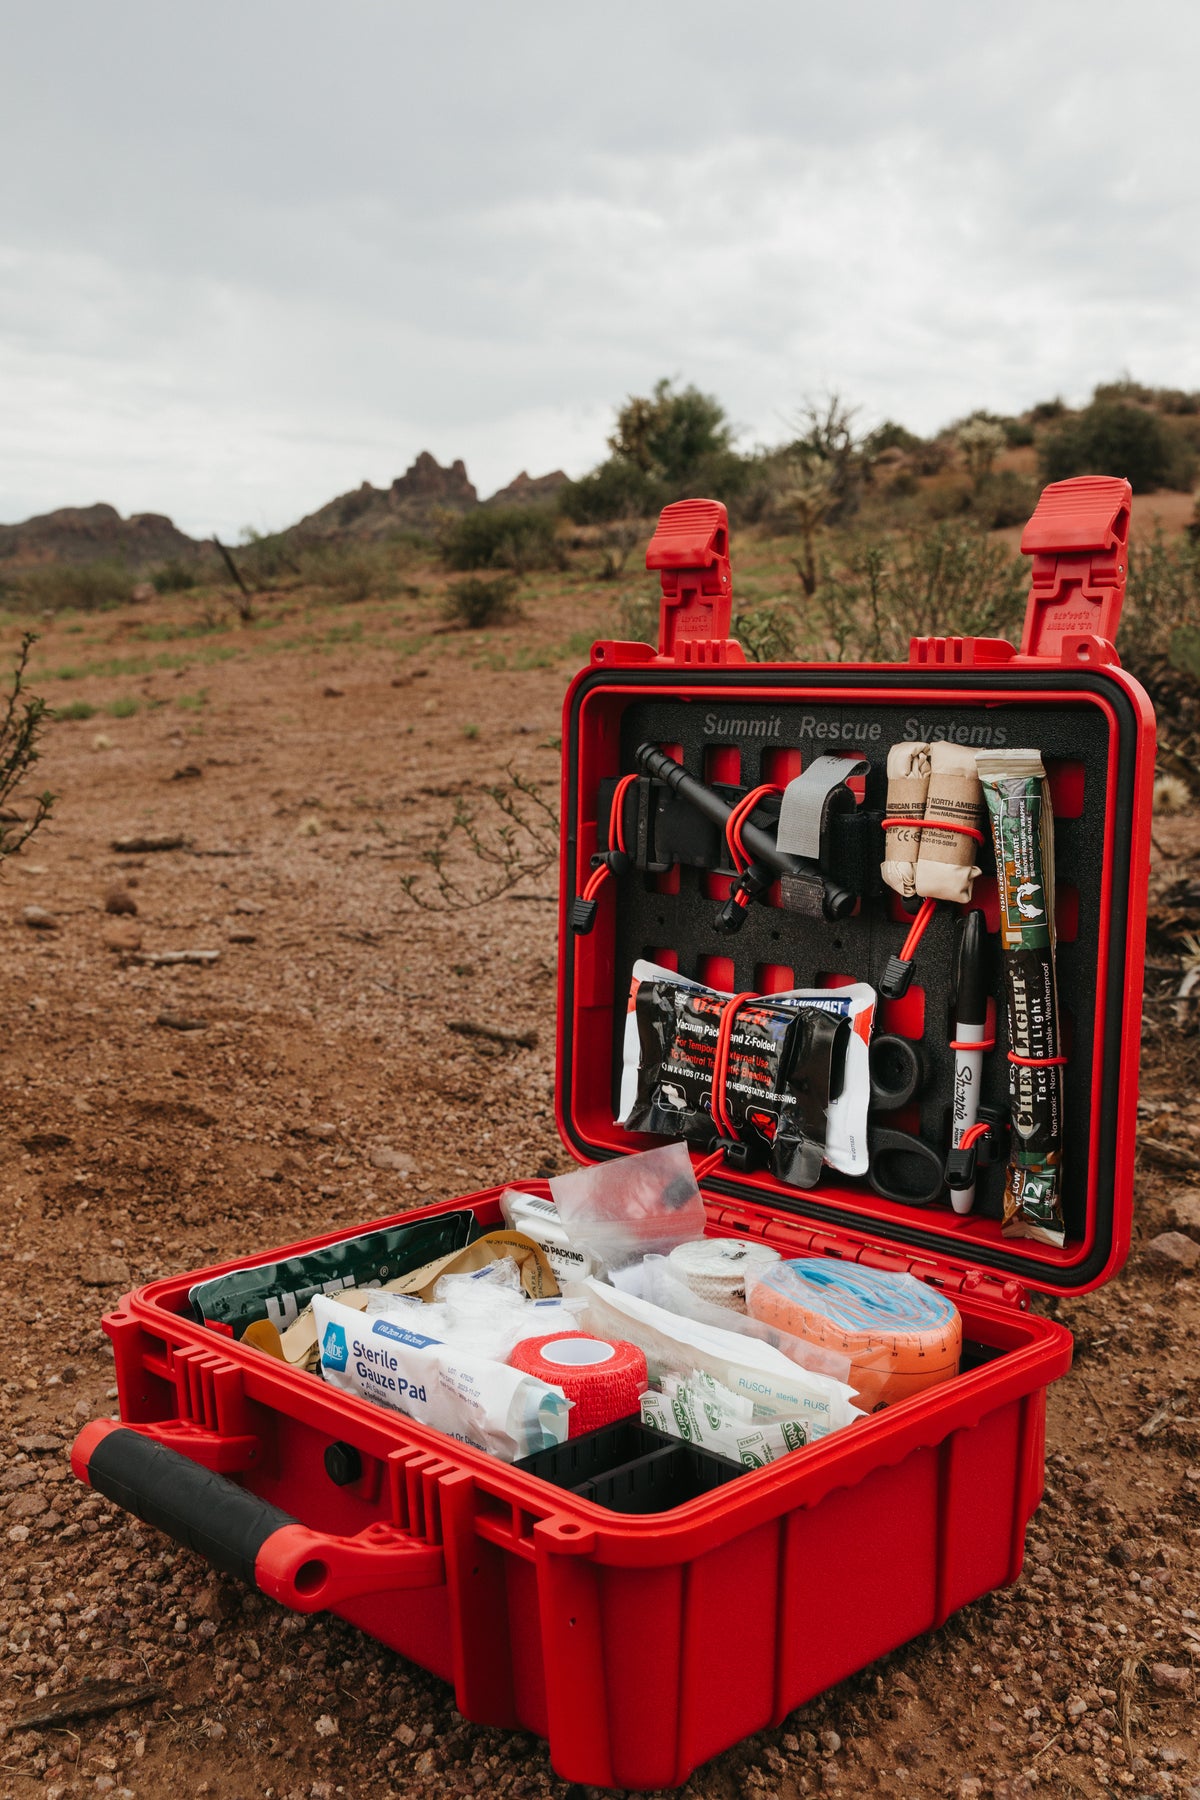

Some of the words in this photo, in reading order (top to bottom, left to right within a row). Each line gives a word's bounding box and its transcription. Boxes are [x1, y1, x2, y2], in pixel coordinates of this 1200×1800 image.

[703, 713, 782, 736] Summit
[800, 716, 882, 740] Rescue
[903, 718, 1008, 745] Systems
[930, 798, 954, 806] NORTH
[1042, 962, 1052, 1021] Weatherproof
[1031, 998, 1044, 1038] Light
[676, 1018, 704, 1034] Vacuum
[730, 1033, 744, 1044] and
[744, 1036, 776, 1052] Z-Folded
[675, 1036, 687, 1047] For
[730, 1051, 755, 1065] xternal
[756, 1057, 769, 1068] Use
[680, 1052, 706, 1067] Control
[1046, 1026, 1056, 1090] Non-fmmable
[682, 1068, 694, 1079] YDS
[732, 1082, 766, 1098] HEMOSTATIC
[766, 1089, 797, 1106] DRESSING
[1032, 1044, 1047, 1102] Tactal
[1023, 1182, 1043, 1204] 12
[1044, 1188, 1052, 1206] HOUR
[550, 1246, 584, 1262] PACKING
[352, 1340, 398, 1371] Sterile
[356, 1361, 396, 1391] Gauze
[398, 1378, 427, 1402] Pad
[738, 1378, 772, 1396] RUSCH
[776, 1392, 798, 1404] sterile
[673, 1400, 690, 1440] CURAD
[784, 1422, 800, 1450] URAD
[740, 1434, 760, 1446] STERILE
